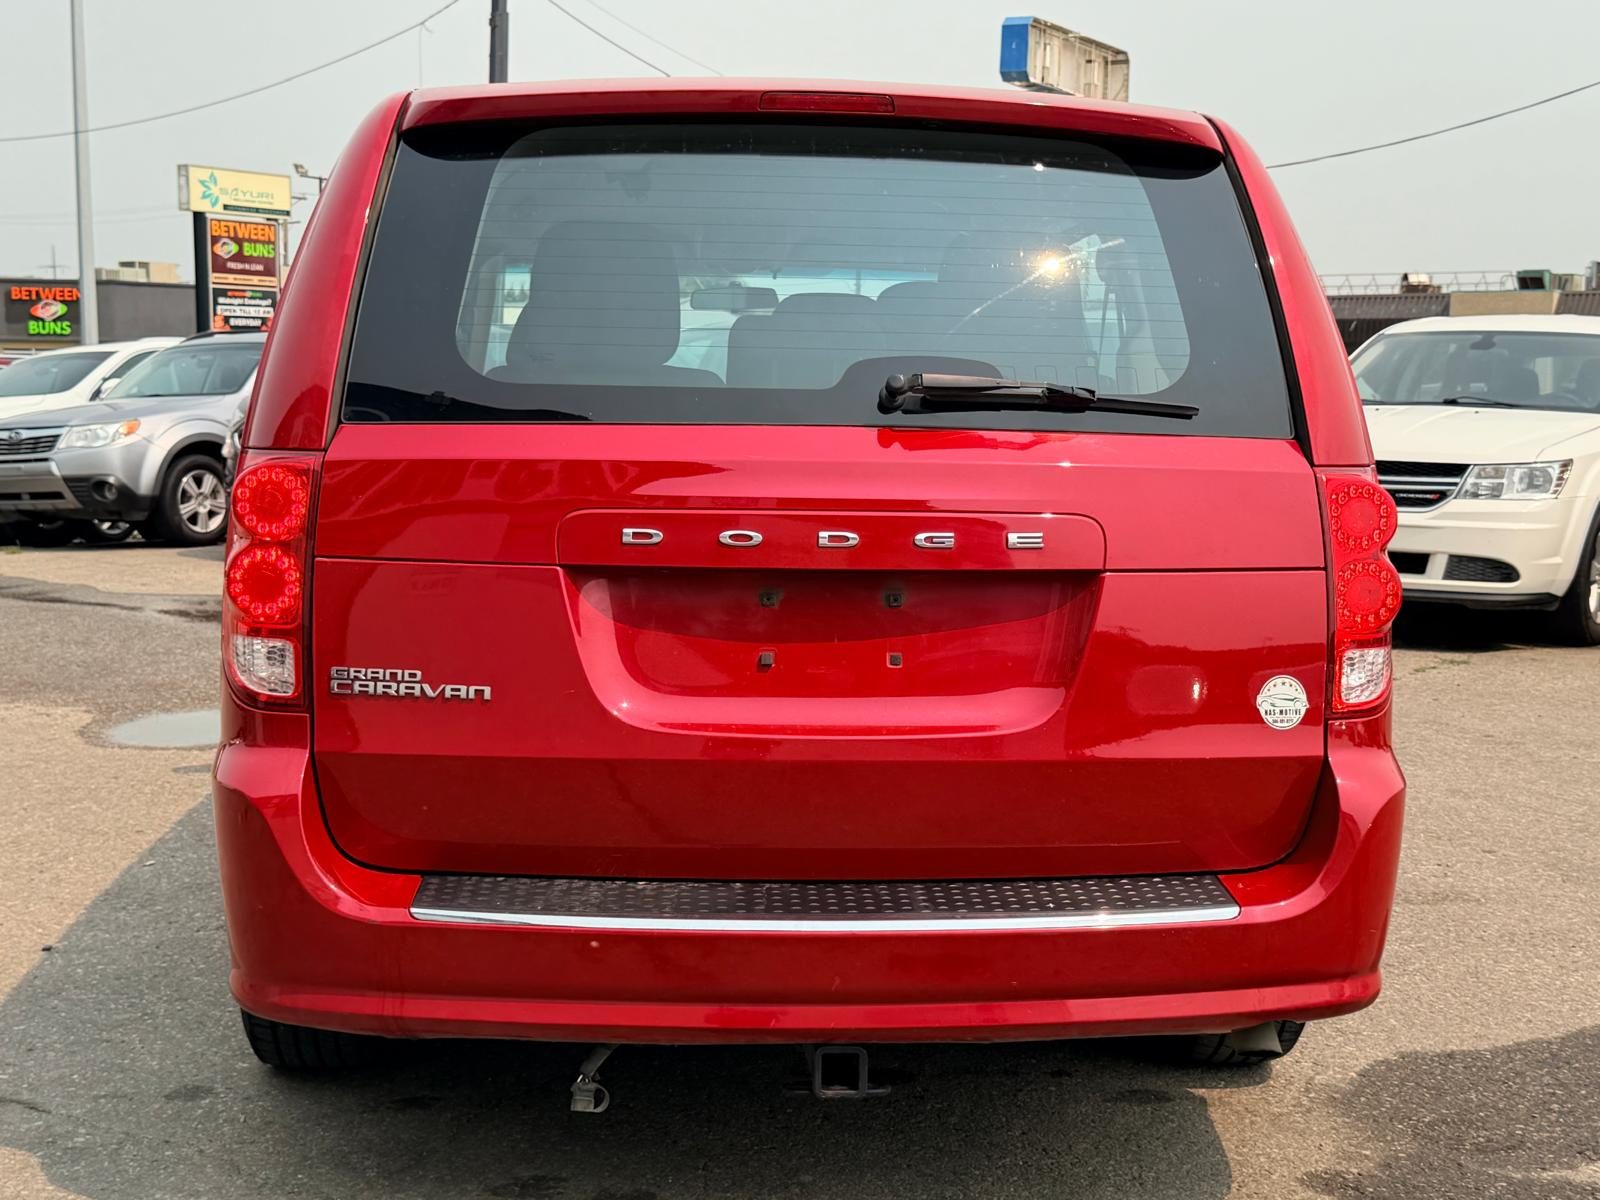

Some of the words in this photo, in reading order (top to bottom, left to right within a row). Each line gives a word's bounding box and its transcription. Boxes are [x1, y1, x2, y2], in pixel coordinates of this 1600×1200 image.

[211, 220, 275, 242] BETWEEN
[243, 242, 275, 258] BUNS
[28, 320, 72, 335] BUNS
[622, 527, 1045, 550] DODGE
[330, 666, 422, 682] GRAND
[330, 679, 492, 701] CARAVAN
